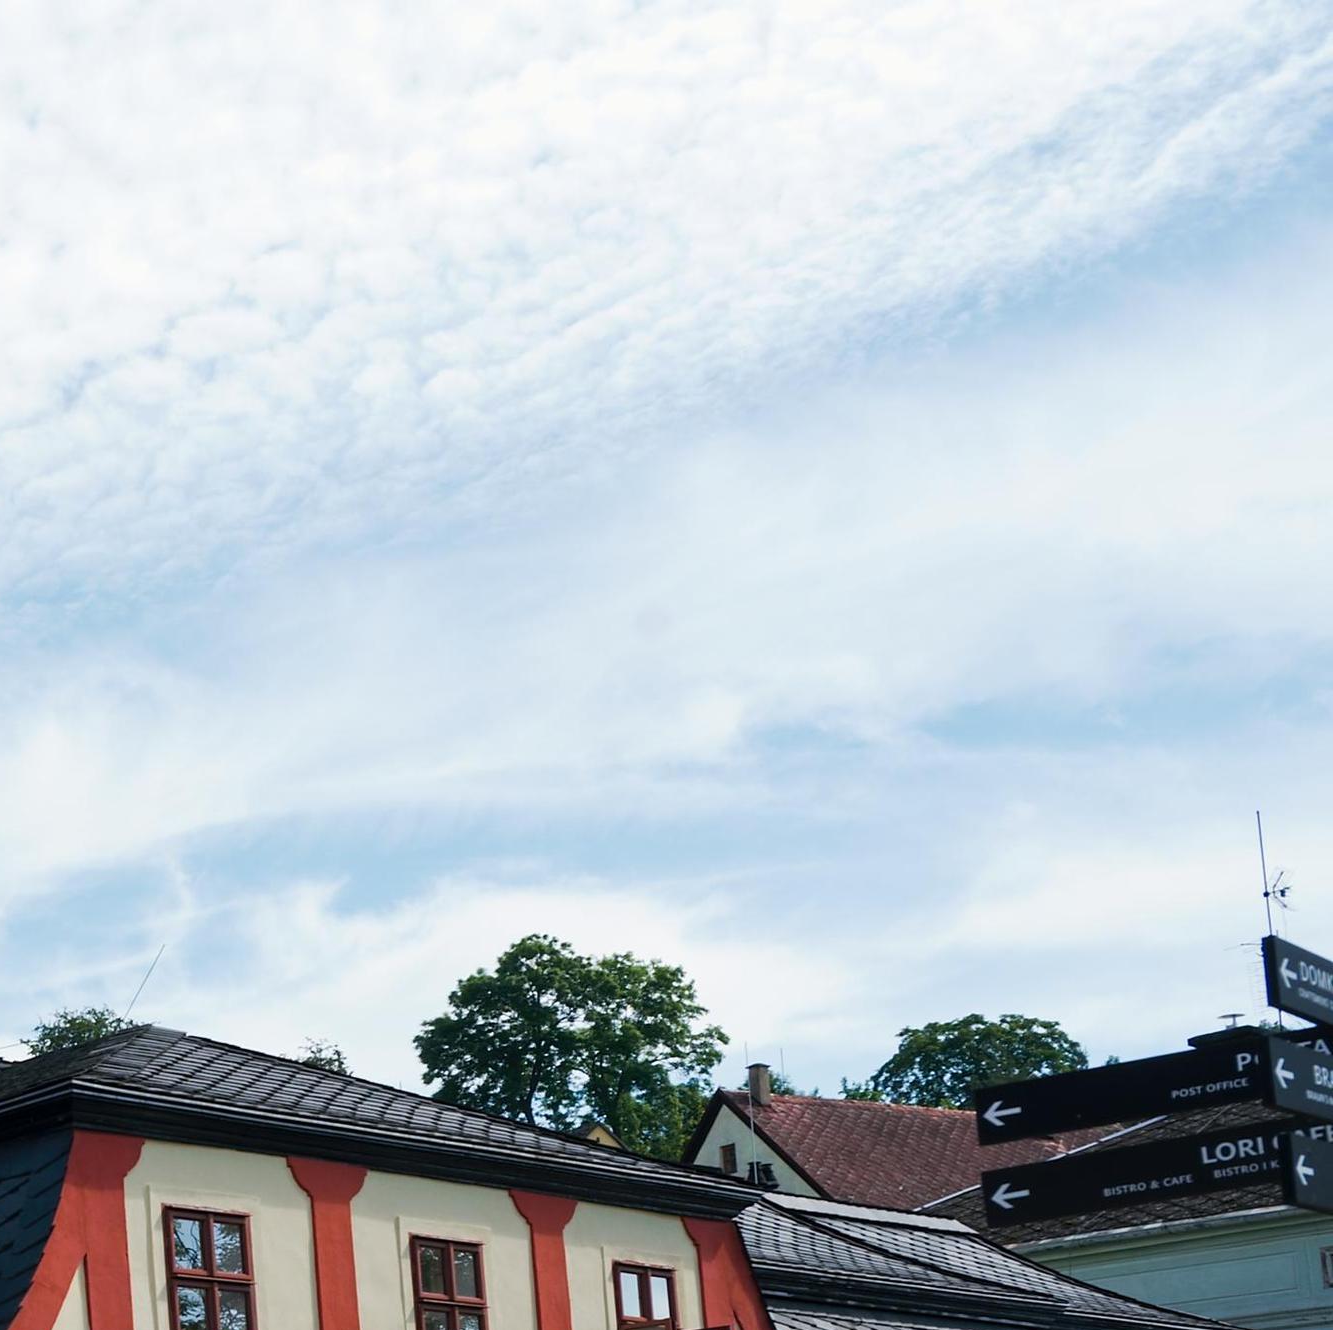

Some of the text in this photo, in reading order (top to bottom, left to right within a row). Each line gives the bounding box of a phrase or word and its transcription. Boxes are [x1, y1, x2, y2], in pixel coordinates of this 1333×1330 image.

[1171, 1077, 1250, 1100] POST OFFICE
[1200, 1136, 1266, 1165] LORI
[1213, 1163, 1259, 1179] BISTRO
[1103, 1174, 1194, 1198] BISTRO & CAFE
